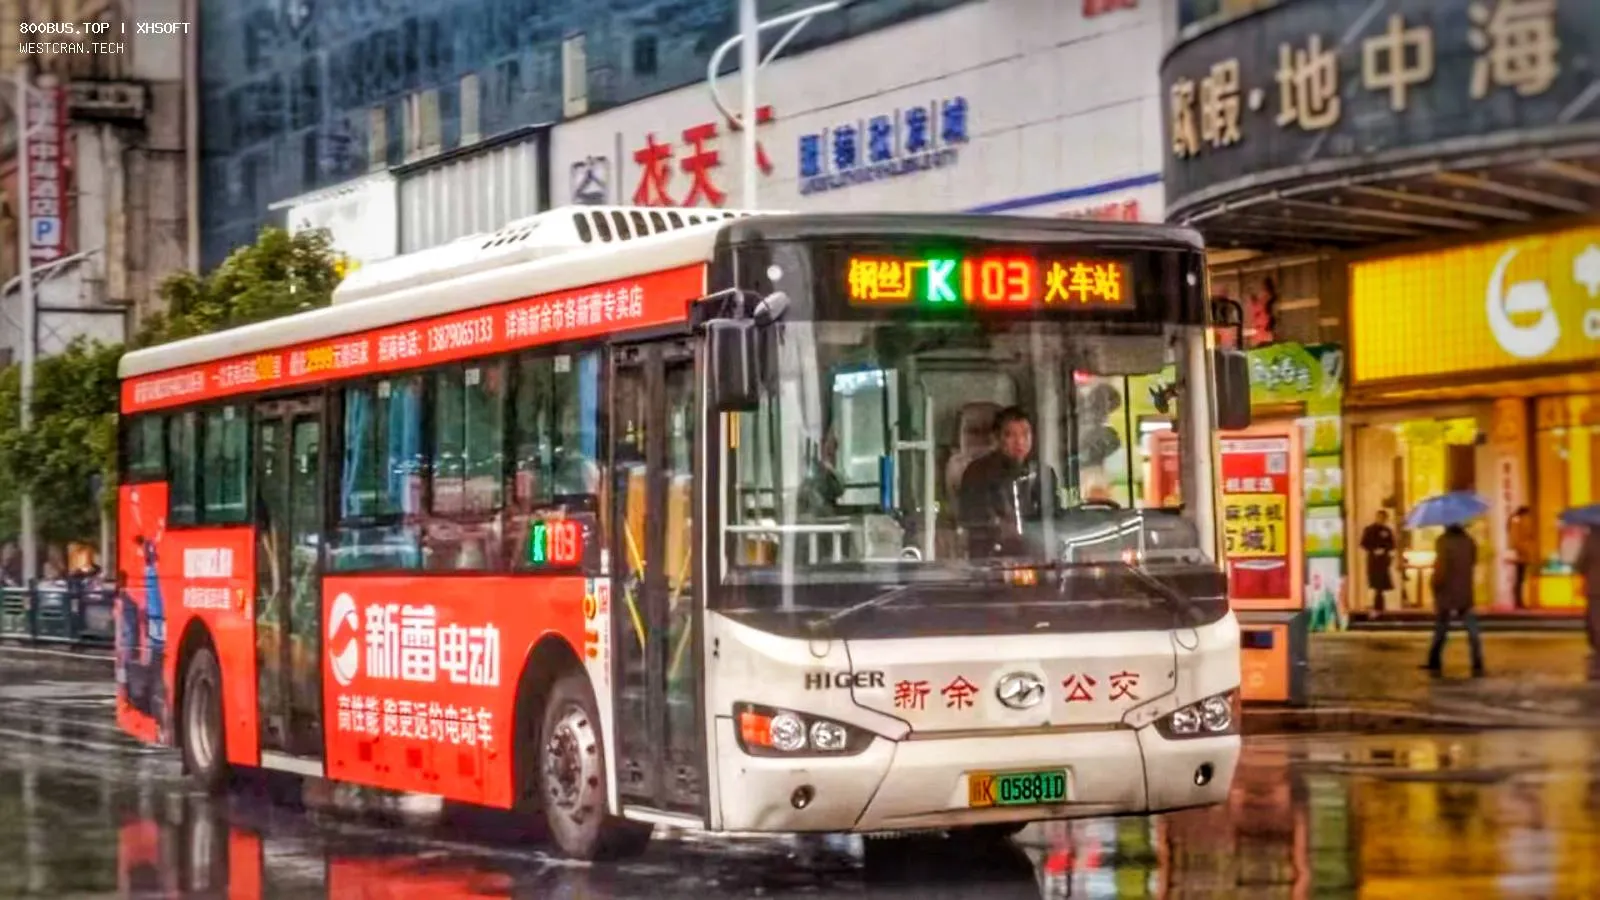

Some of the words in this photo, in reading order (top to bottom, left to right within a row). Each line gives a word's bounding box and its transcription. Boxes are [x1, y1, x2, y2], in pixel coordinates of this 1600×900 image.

[37, 221, 53, 241] P
[849, 259, 928, 299] 钢丝厂
[1045, 261, 1121, 302] 火车站
[533, 523, 577, 561] K103
[365, 603, 500, 687] 新蕾电动
[804, 671, 885, 690] HIGER
[894, 675, 979, 711] 新余
[1062, 671, 1141, 702] 公交
[337, 694, 380, 735] 高性能
[383, 698, 493, 750] 跑更远的电动车
